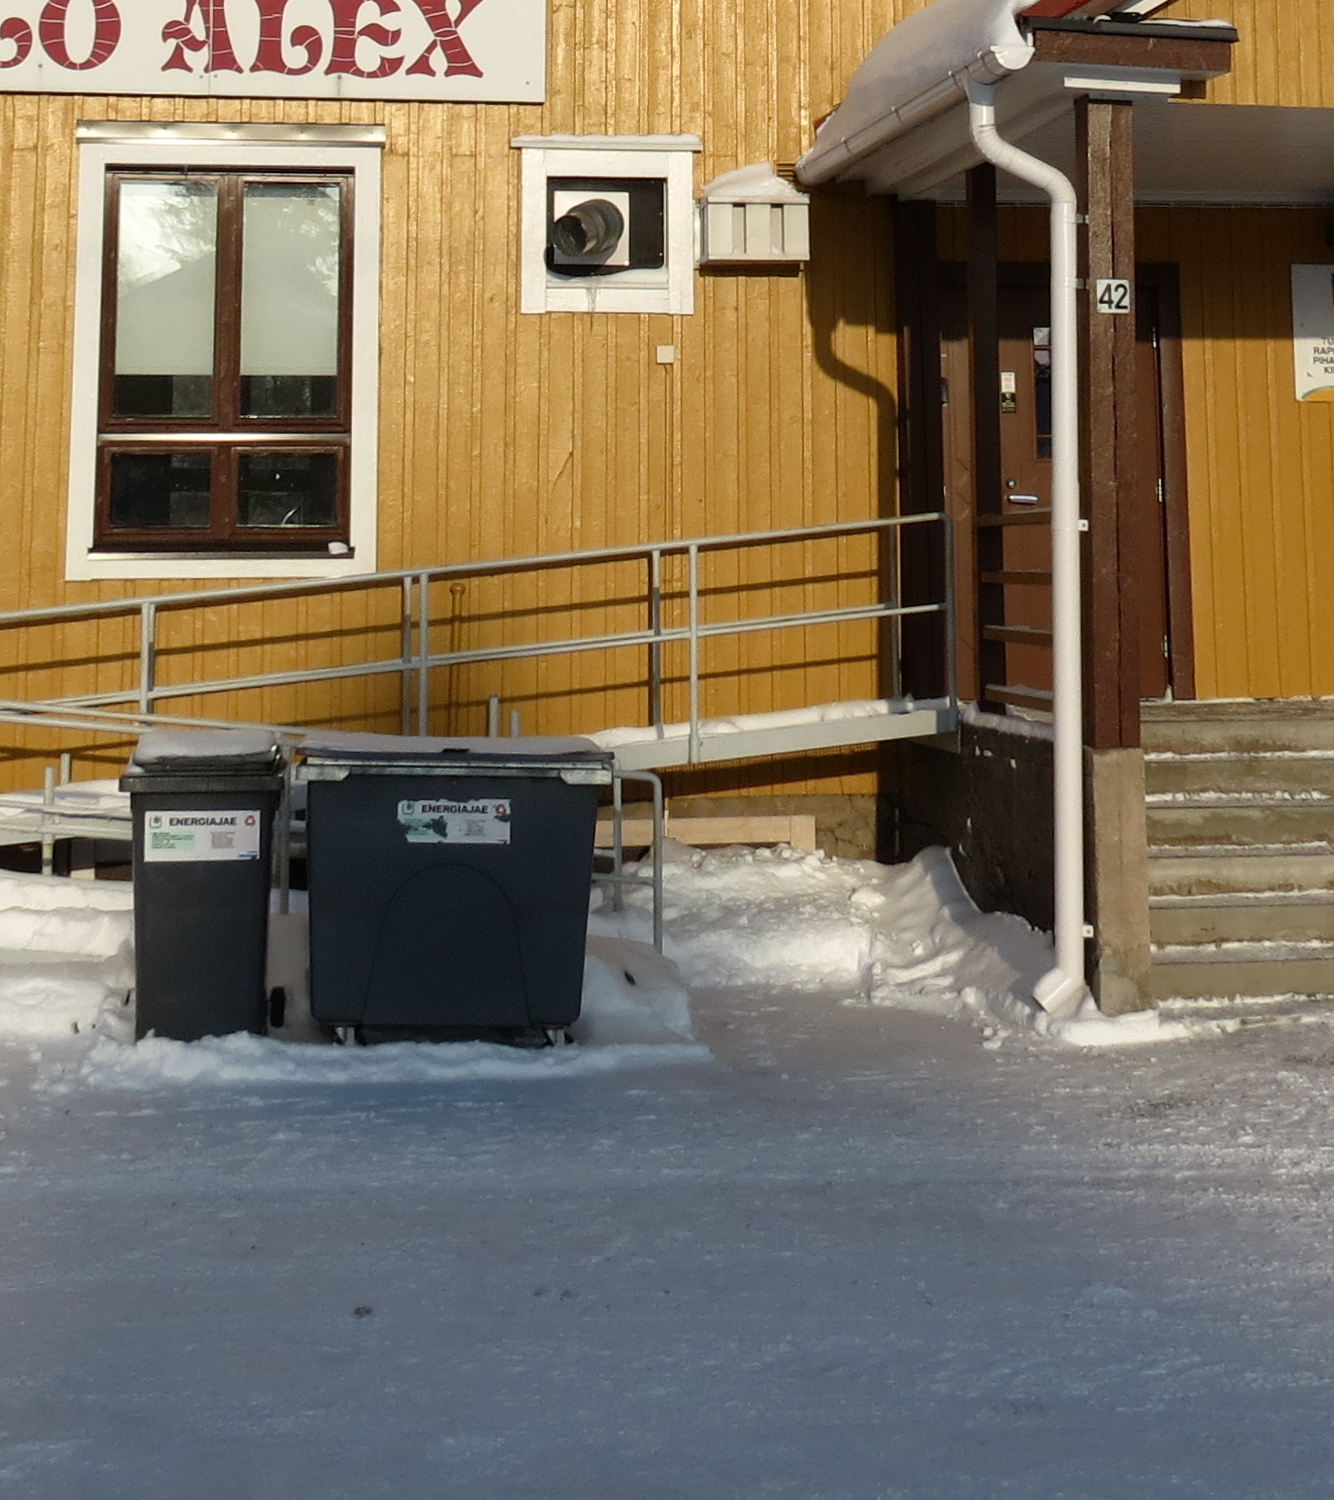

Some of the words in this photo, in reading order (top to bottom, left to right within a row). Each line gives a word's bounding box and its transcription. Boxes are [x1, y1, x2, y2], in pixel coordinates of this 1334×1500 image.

[1098, 284, 1129, 310] 42
[421, 804, 489, 814] ENERGIAJAE
[169, 817, 237, 826] ENERGIAJAE
